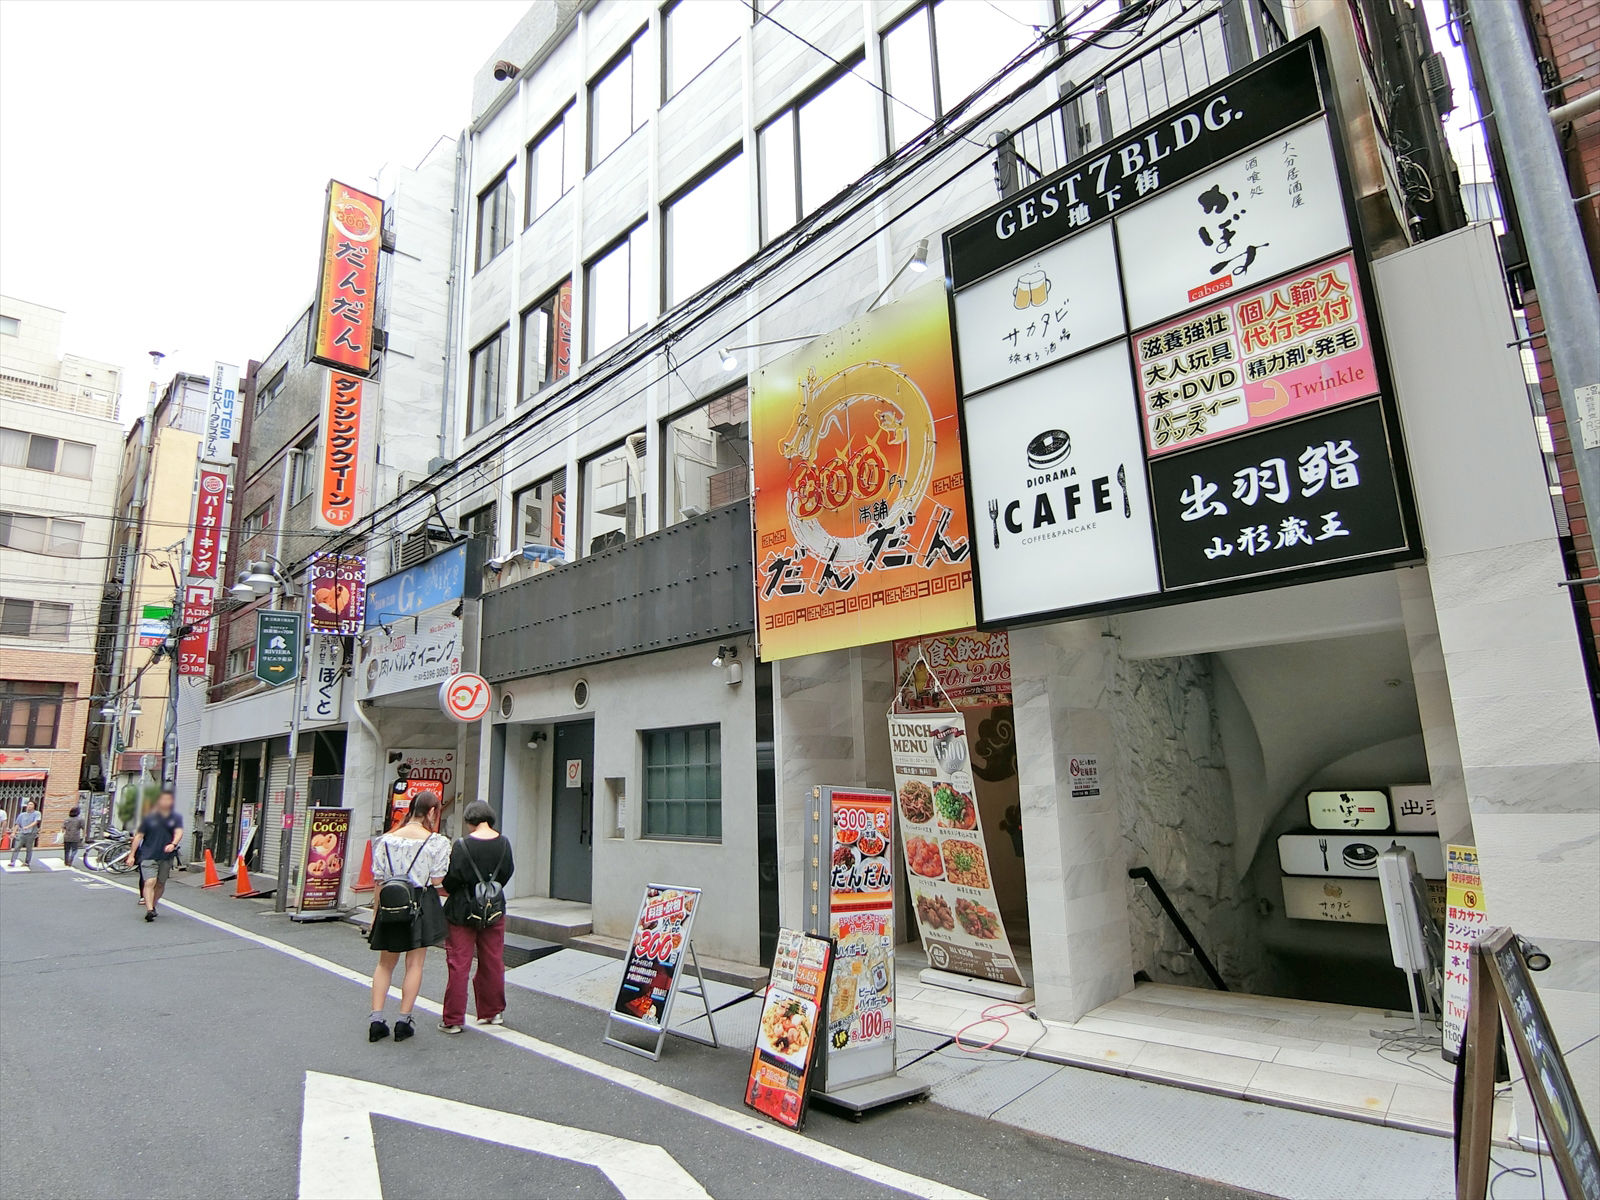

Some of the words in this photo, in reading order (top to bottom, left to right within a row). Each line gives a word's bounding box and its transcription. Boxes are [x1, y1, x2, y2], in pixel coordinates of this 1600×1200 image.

[993, 176, 1081, 241] GEST
[1090, 156, 1111, 193] 7
[1117, 94, 1245, 179] BLDG.
[1244, 157, 1265, 199] 酒喰処
[1282, 140, 1305, 209] 大分居酒屋
[1067, 169, 1160, 229] 地下街
[1197, 183, 1270, 277] かぼす
[329, 240, 370, 354] だんだん
[1191, 278, 1231, 302] caboss
[1238, 271, 1347, 327] 個人輸入
[1001, 298, 1070, 344] サカタビ
[1141, 312, 1228, 361] 滋養強壮
[1242, 295, 1350, 354] 代行受付
[1146, 341, 1233, 386] 大人玩具
[1248, 329, 1358, 381] 精力剤・発毛
[1149, 369, 1237, 410] 本・DVD
[1290, 367, 1365, 399] Twinkle
[220, 389, 236, 440] ESTEM
[1154, 396, 1238, 431] パーティー
[1156, 419, 1204, 447] グッズ
[327, 376, 361, 509] ダンシングクイーン
[1025, 466, 1077, 489] DIORAMA
[1178, 439, 1360, 523] 出羽鮨
[325, 507, 349, 522] 6F
[1003, 474, 1114, 534] CAFE
[197, 494, 220, 573] バーガーキング
[757, 505, 970, 602] だんだん
[1021, 521, 1097, 546] COFFEE&PANCAKE
[1202, 511, 1350, 560] 山形蔵王
[186, 607, 209, 618] 入口は
[316, 667, 336, 716] ほくと
[891, 724, 934, 738] LUNCH
[892, 739, 928, 754] MENU
[395, 782, 408, 791] 4F
[312, 821, 348, 832] CoCo8
[830, 864, 892, 889] だんだん
[1445, 1021, 1461, 1033] OPEN
